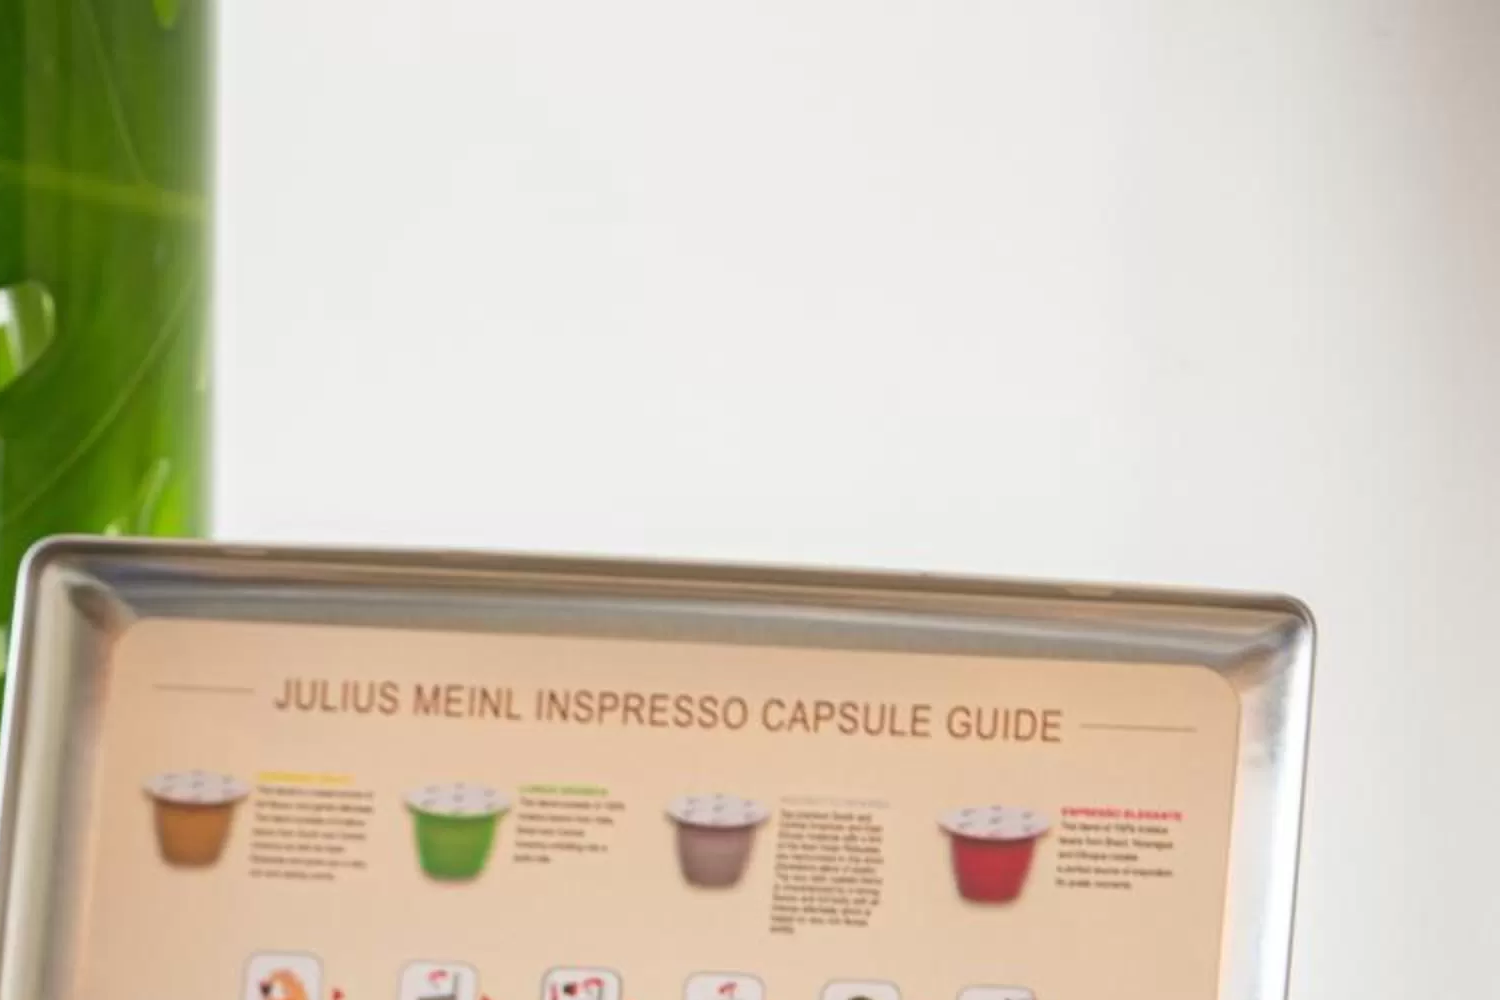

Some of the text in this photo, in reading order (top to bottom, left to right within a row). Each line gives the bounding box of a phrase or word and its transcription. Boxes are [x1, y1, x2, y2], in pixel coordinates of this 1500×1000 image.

[274, 678, 1062, 744] JULIUS MEINL INSPRESSO CAPSULE GUIDE
